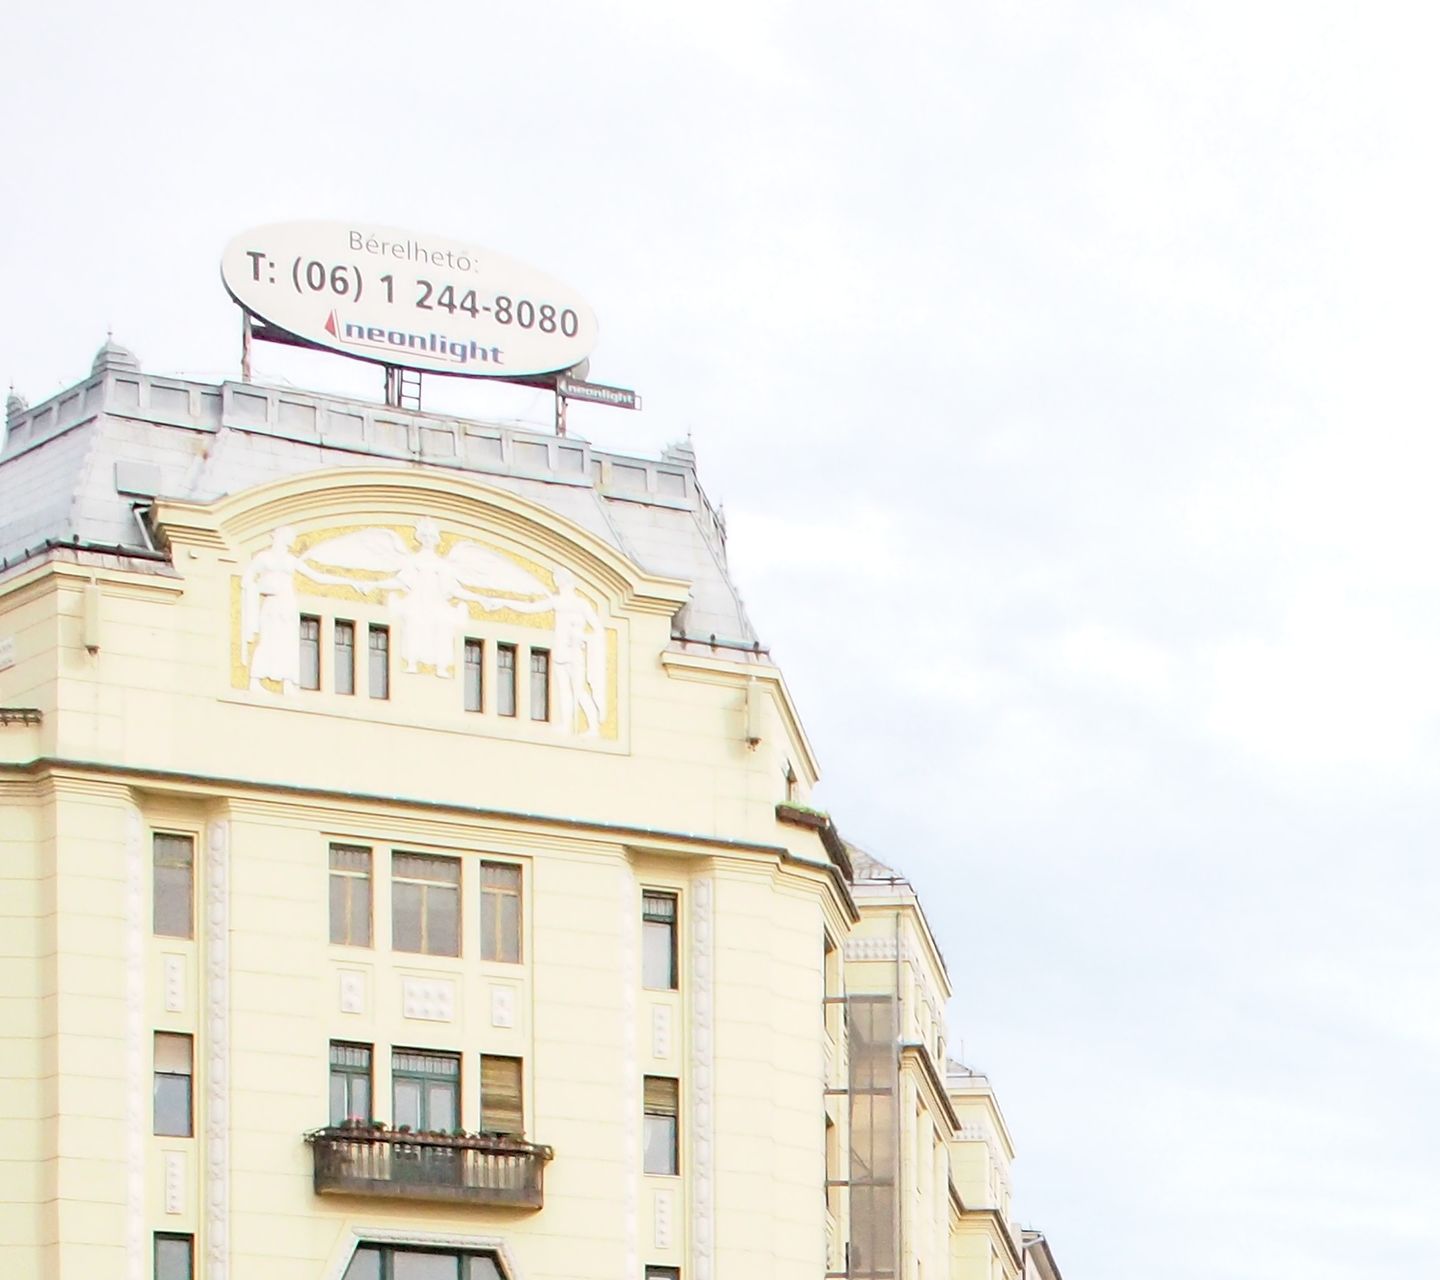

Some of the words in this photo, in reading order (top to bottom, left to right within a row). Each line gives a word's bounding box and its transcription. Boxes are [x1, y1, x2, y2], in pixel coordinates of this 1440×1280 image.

[246, 250, 276, 284] T:
[292, 256, 363, 303] (06)
[379, 273, 394, 304] 1
[415, 279, 579, 338] 244-8080
[345, 322, 504, 365] neonlight
[567, 383, 635, 405] neonlight
